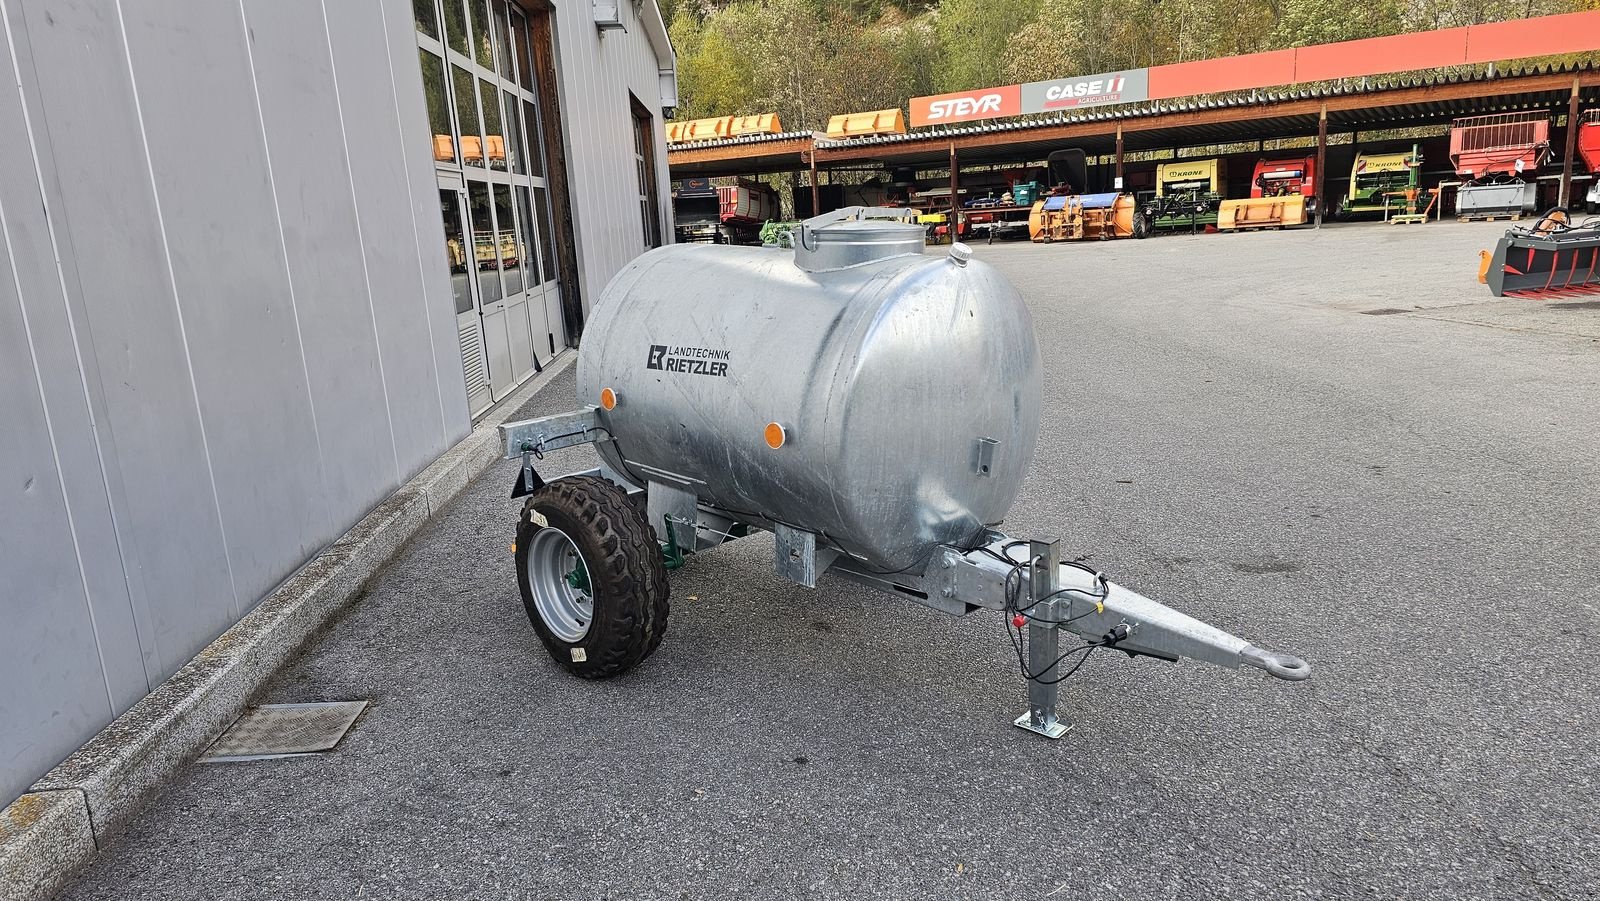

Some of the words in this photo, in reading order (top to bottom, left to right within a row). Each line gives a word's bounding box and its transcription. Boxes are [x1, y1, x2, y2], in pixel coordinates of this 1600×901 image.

[1046, 80, 1103, 100] CASE
[1078, 94, 1118, 104] AGRICULTURE
[927, 94, 1002, 119] STEYR
[668, 346, 731, 360] LANDTECHNIK
[666, 358, 728, 377] RIETZLER
